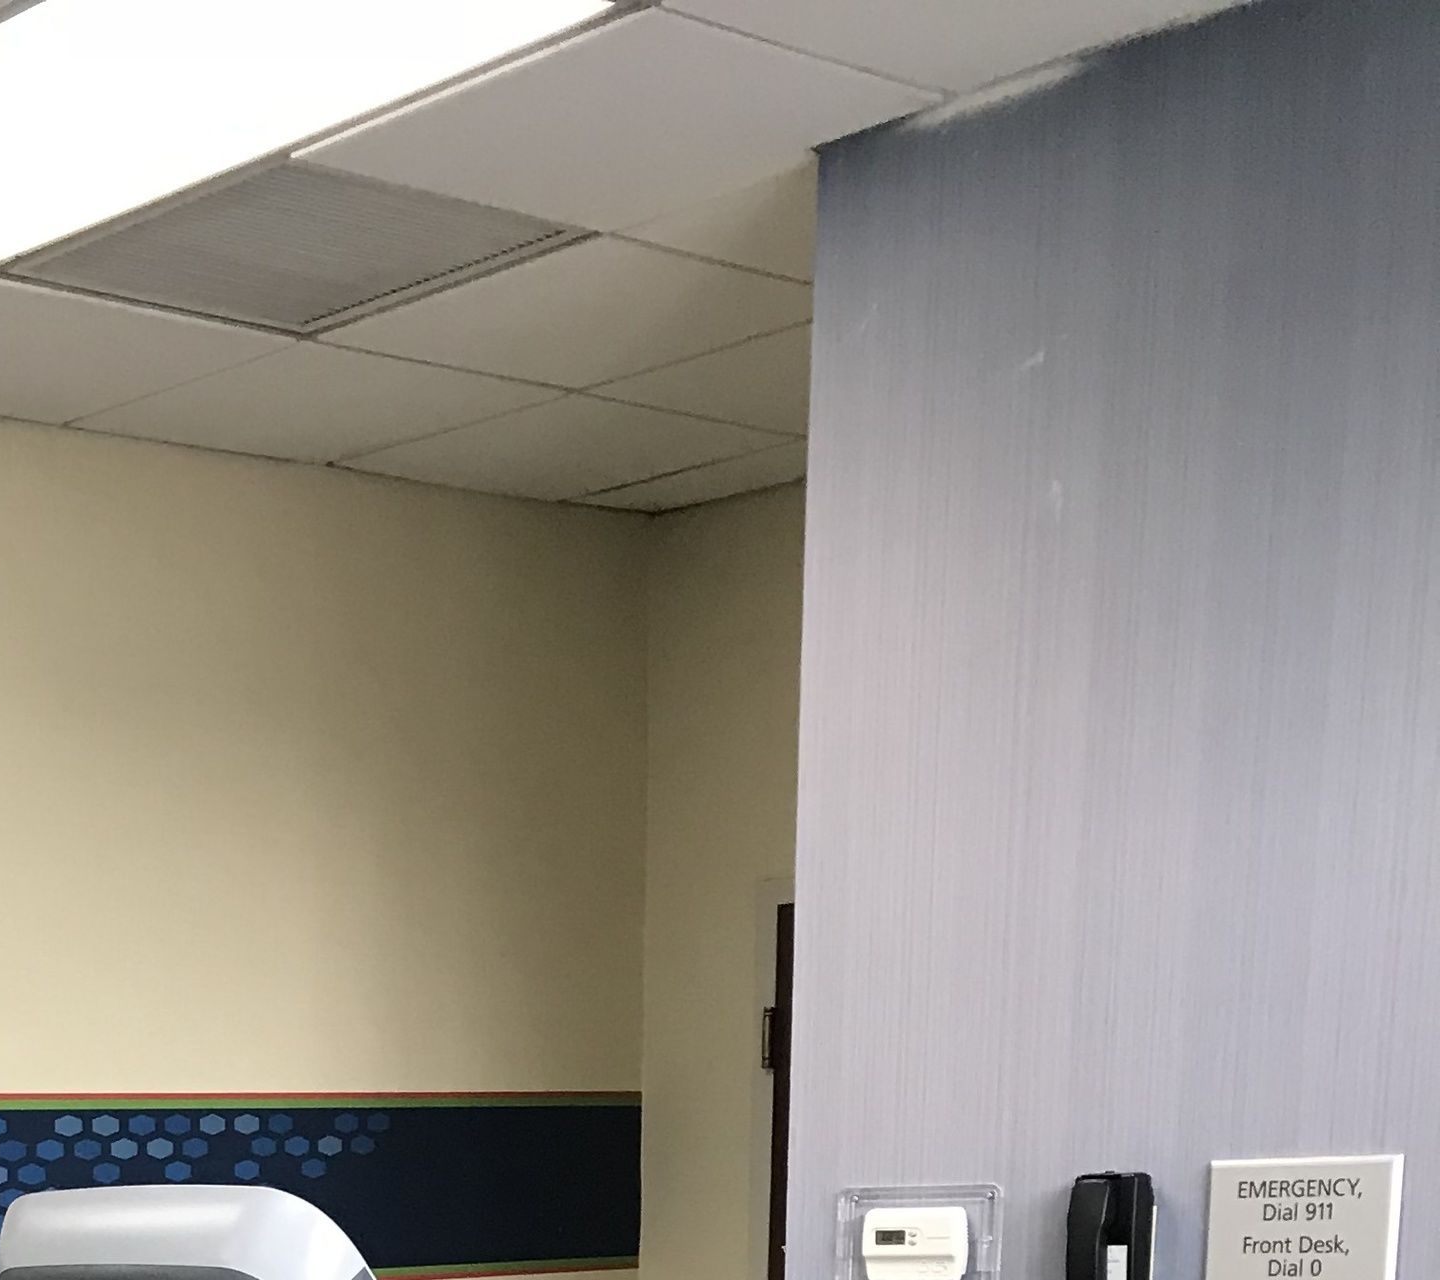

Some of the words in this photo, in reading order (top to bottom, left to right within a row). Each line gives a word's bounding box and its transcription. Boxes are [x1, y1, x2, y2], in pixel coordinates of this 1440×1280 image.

[1237, 1178, 1363, 1199] EMERGENCY,
[1262, 1202, 1299, 1221] Dial
[1305, 1202, 1334, 1221] 911
[1242, 1236, 1292, 1254] Front
[1298, 1234, 1350, 1256] Desk,
[1267, 1258, 1303, 1277] Dial
[1310, 1258, 1322, 1277] 0
